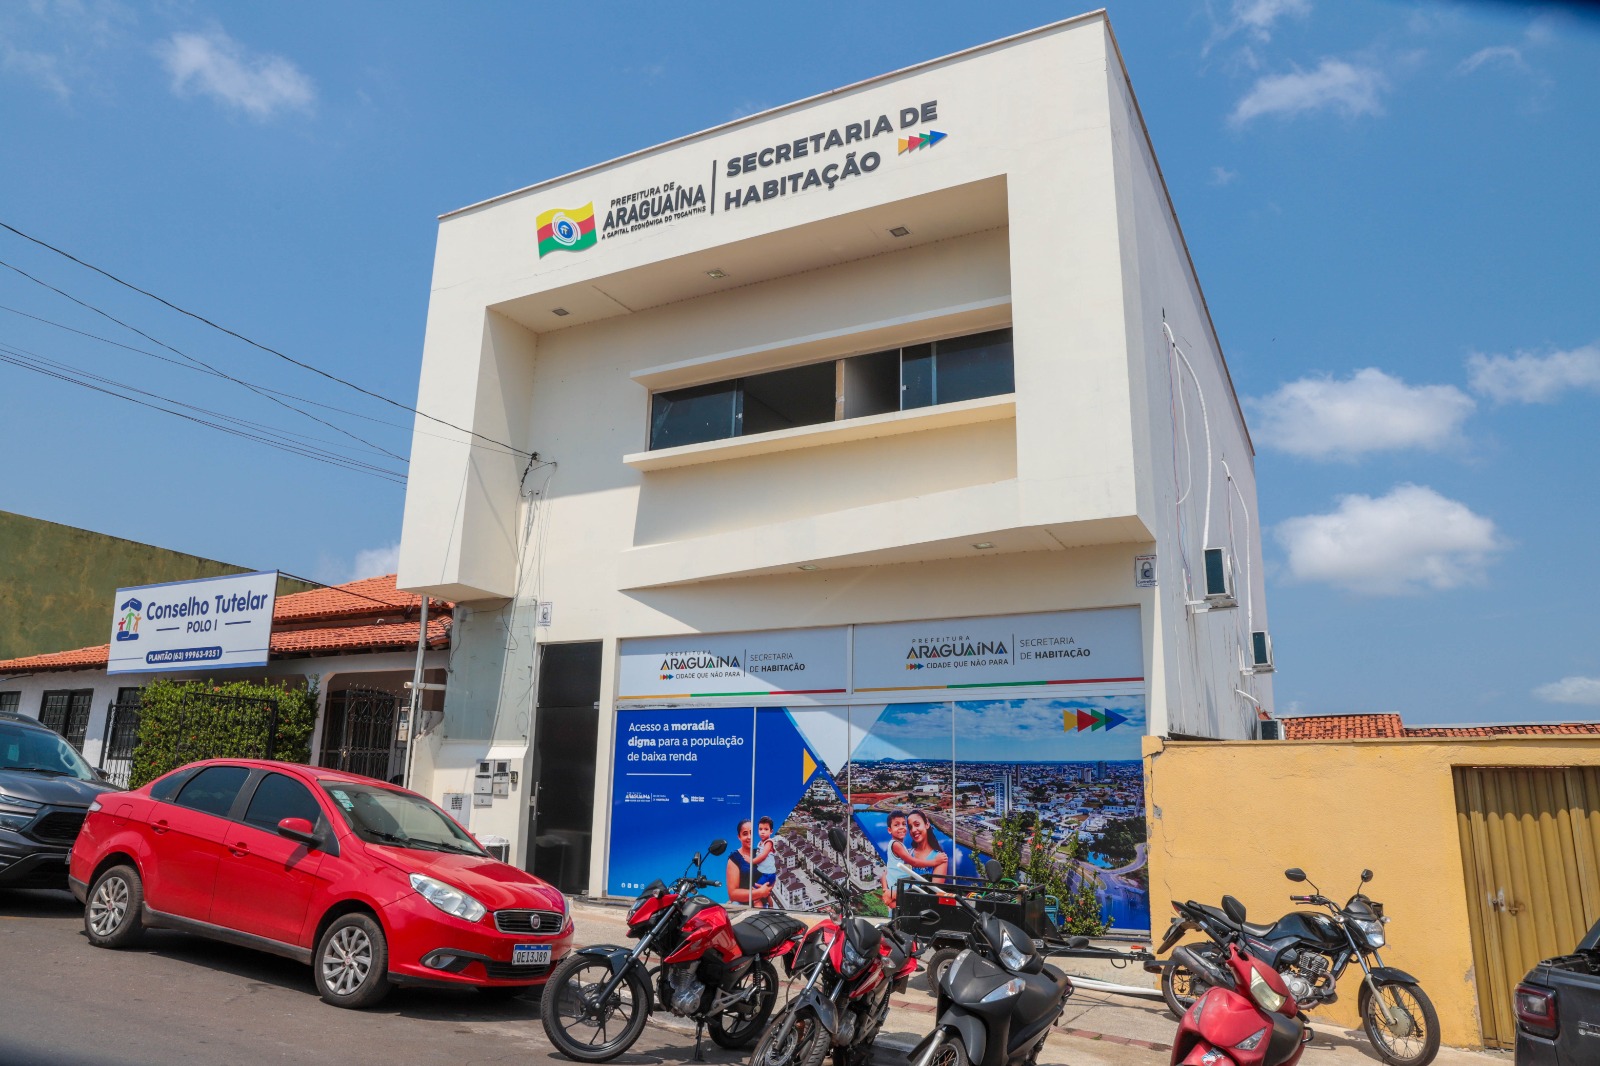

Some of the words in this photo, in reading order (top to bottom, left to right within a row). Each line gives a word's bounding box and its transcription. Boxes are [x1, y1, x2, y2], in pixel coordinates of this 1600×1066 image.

[726, 114, 894, 178] SECRETARIA
[900, 100, 938, 129] DE
[724, 151, 881, 211] HABITAÇÃO
[610, 186, 661, 208] PREFEITURA
[663, 181, 675, 192] DE
[602, 184, 706, 232] ARAGUAÍNA
[607, 227, 629, 238] CAPITAL
[664, 214, 673, 222] DO
[673, 205, 706, 219] TOCANTINS
[146, 596, 210, 621] Conselho
[215, 590, 268, 614] Tutelar
[186, 620, 212, 633] POLO
[911, 635, 970, 644] PREFEITURA
[1019, 636, 1075, 648] SECRETARIA
[148, 651, 173, 661] PLANTÃO
[173, 652, 184, 661] (63)
[750, 652, 793, 662] SECRETARIA
[1020, 651, 1032, 660] DE
[1034, 647, 1091, 660] HABITAÇÃO
[749, 665, 759, 673] DE
[761, 663, 806, 673] HABITAÇÃO
[926, 661, 952, 669] CIDADE
[953, 660, 968, 668] QUE
[970, 658, 987, 667] NÃO
[988, 658, 1009, 666] PARA
[675, 672, 696, 680] CIDADE
[696, 671, 709, 679] QUE
[710, 670, 724, 678] NÃO
[628, 722, 661, 732] Acesso
[663, 723, 669, 731] a
[671, 719, 715, 731] moradia
[627, 735, 656, 748] digna
[658, 738, 680, 748] para
[682, 738, 688, 746] a
[690, 735, 744, 748] população
[627, 751, 640, 761] de
[641, 751, 667, 761] baixa
[669, 751, 698, 761] renda
